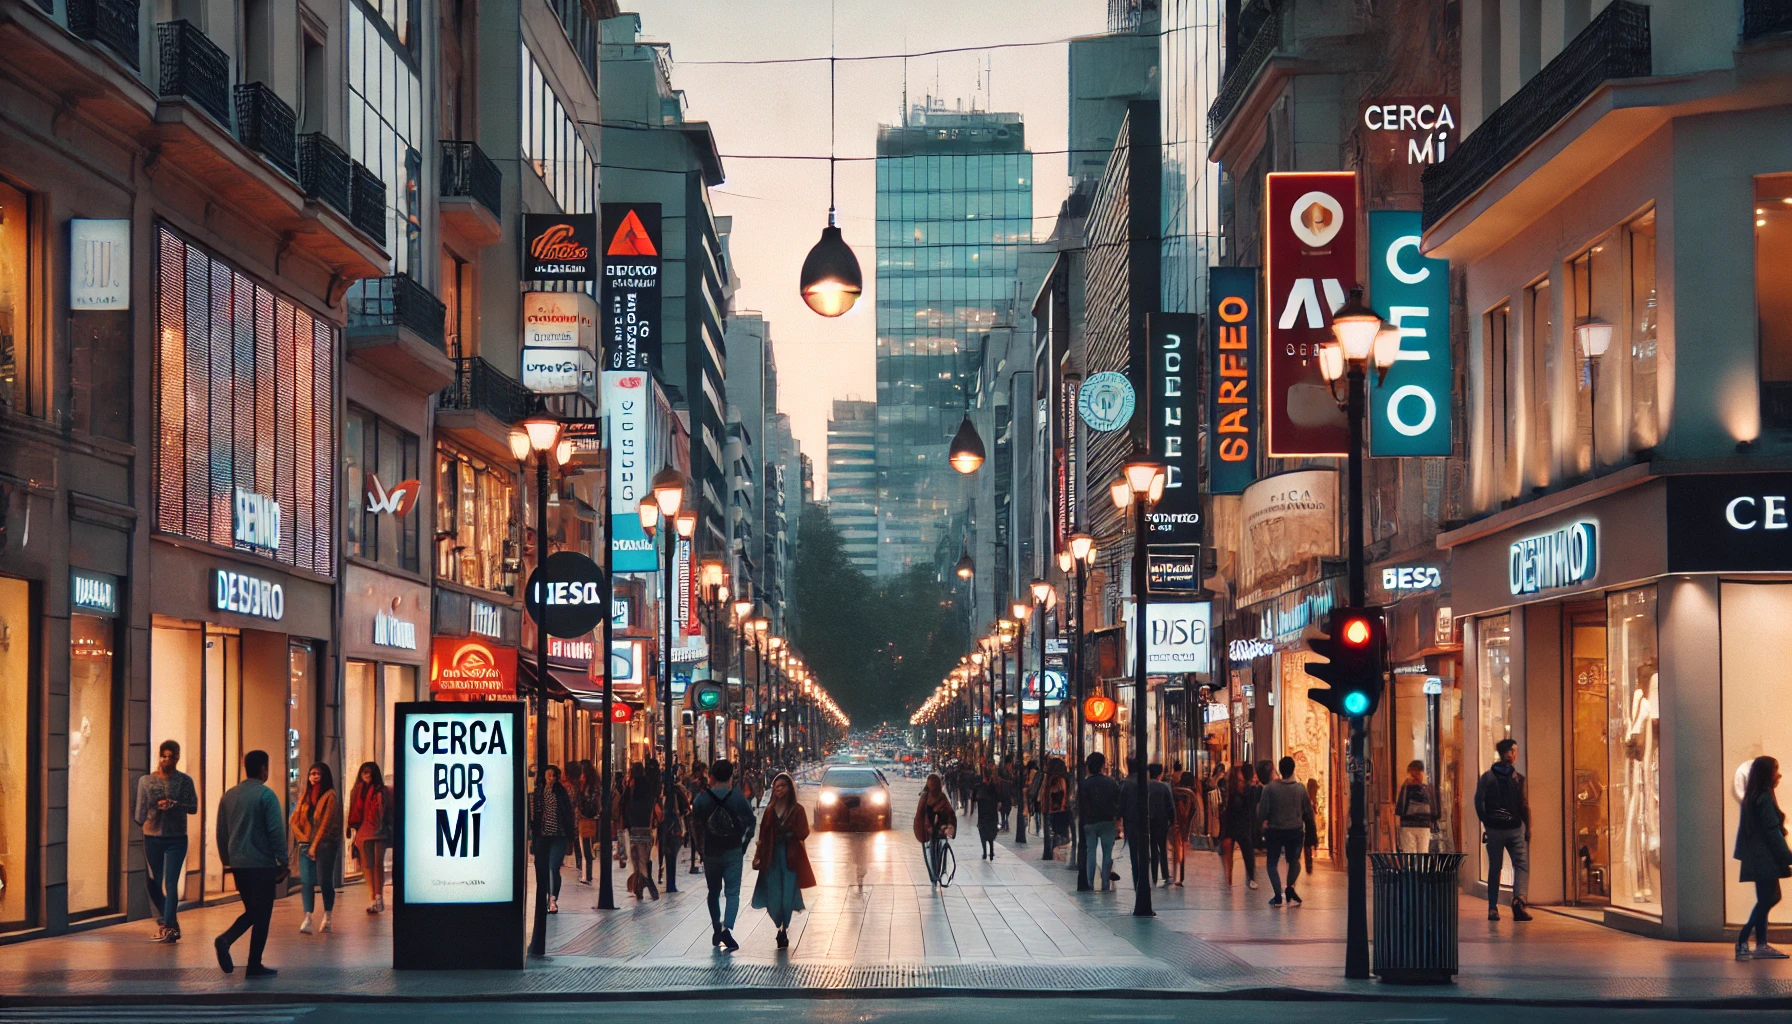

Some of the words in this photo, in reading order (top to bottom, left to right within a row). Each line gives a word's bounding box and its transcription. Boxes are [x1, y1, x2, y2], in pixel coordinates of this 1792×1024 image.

[1364, 104, 1455, 131] CERCA
[1386, 235, 1437, 436] CEO
[1725, 495, 1789, 530] CE
[412, 719, 508, 755] CERCA
